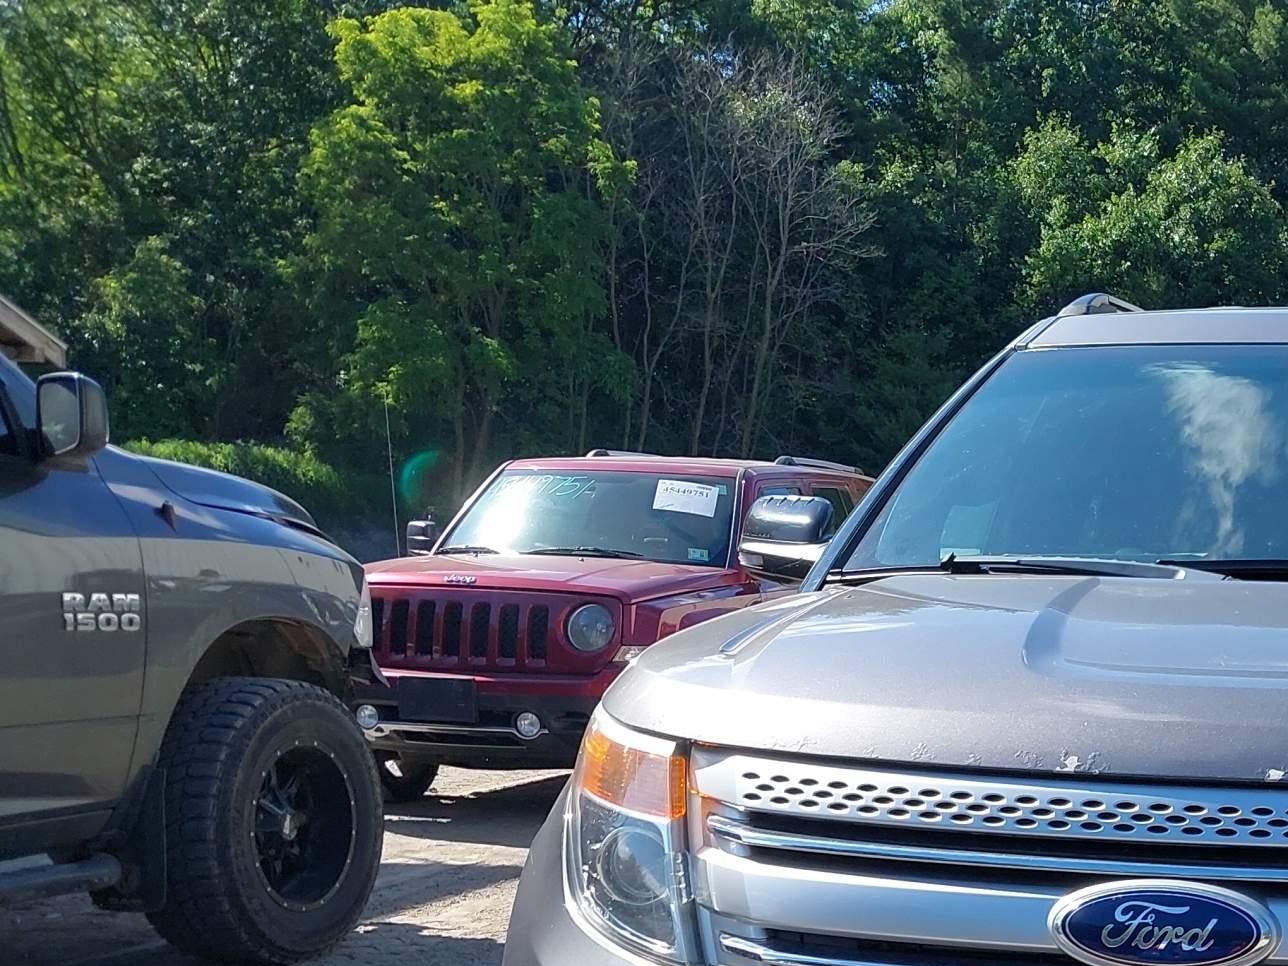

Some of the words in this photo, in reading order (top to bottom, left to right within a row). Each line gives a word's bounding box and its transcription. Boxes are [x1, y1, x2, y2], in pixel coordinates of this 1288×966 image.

[663, 486, 710, 498] 45449751
[62, 592, 140, 611] RAM
[63, 612, 141, 632] 1500
[1101, 901, 1218, 952] Ford
